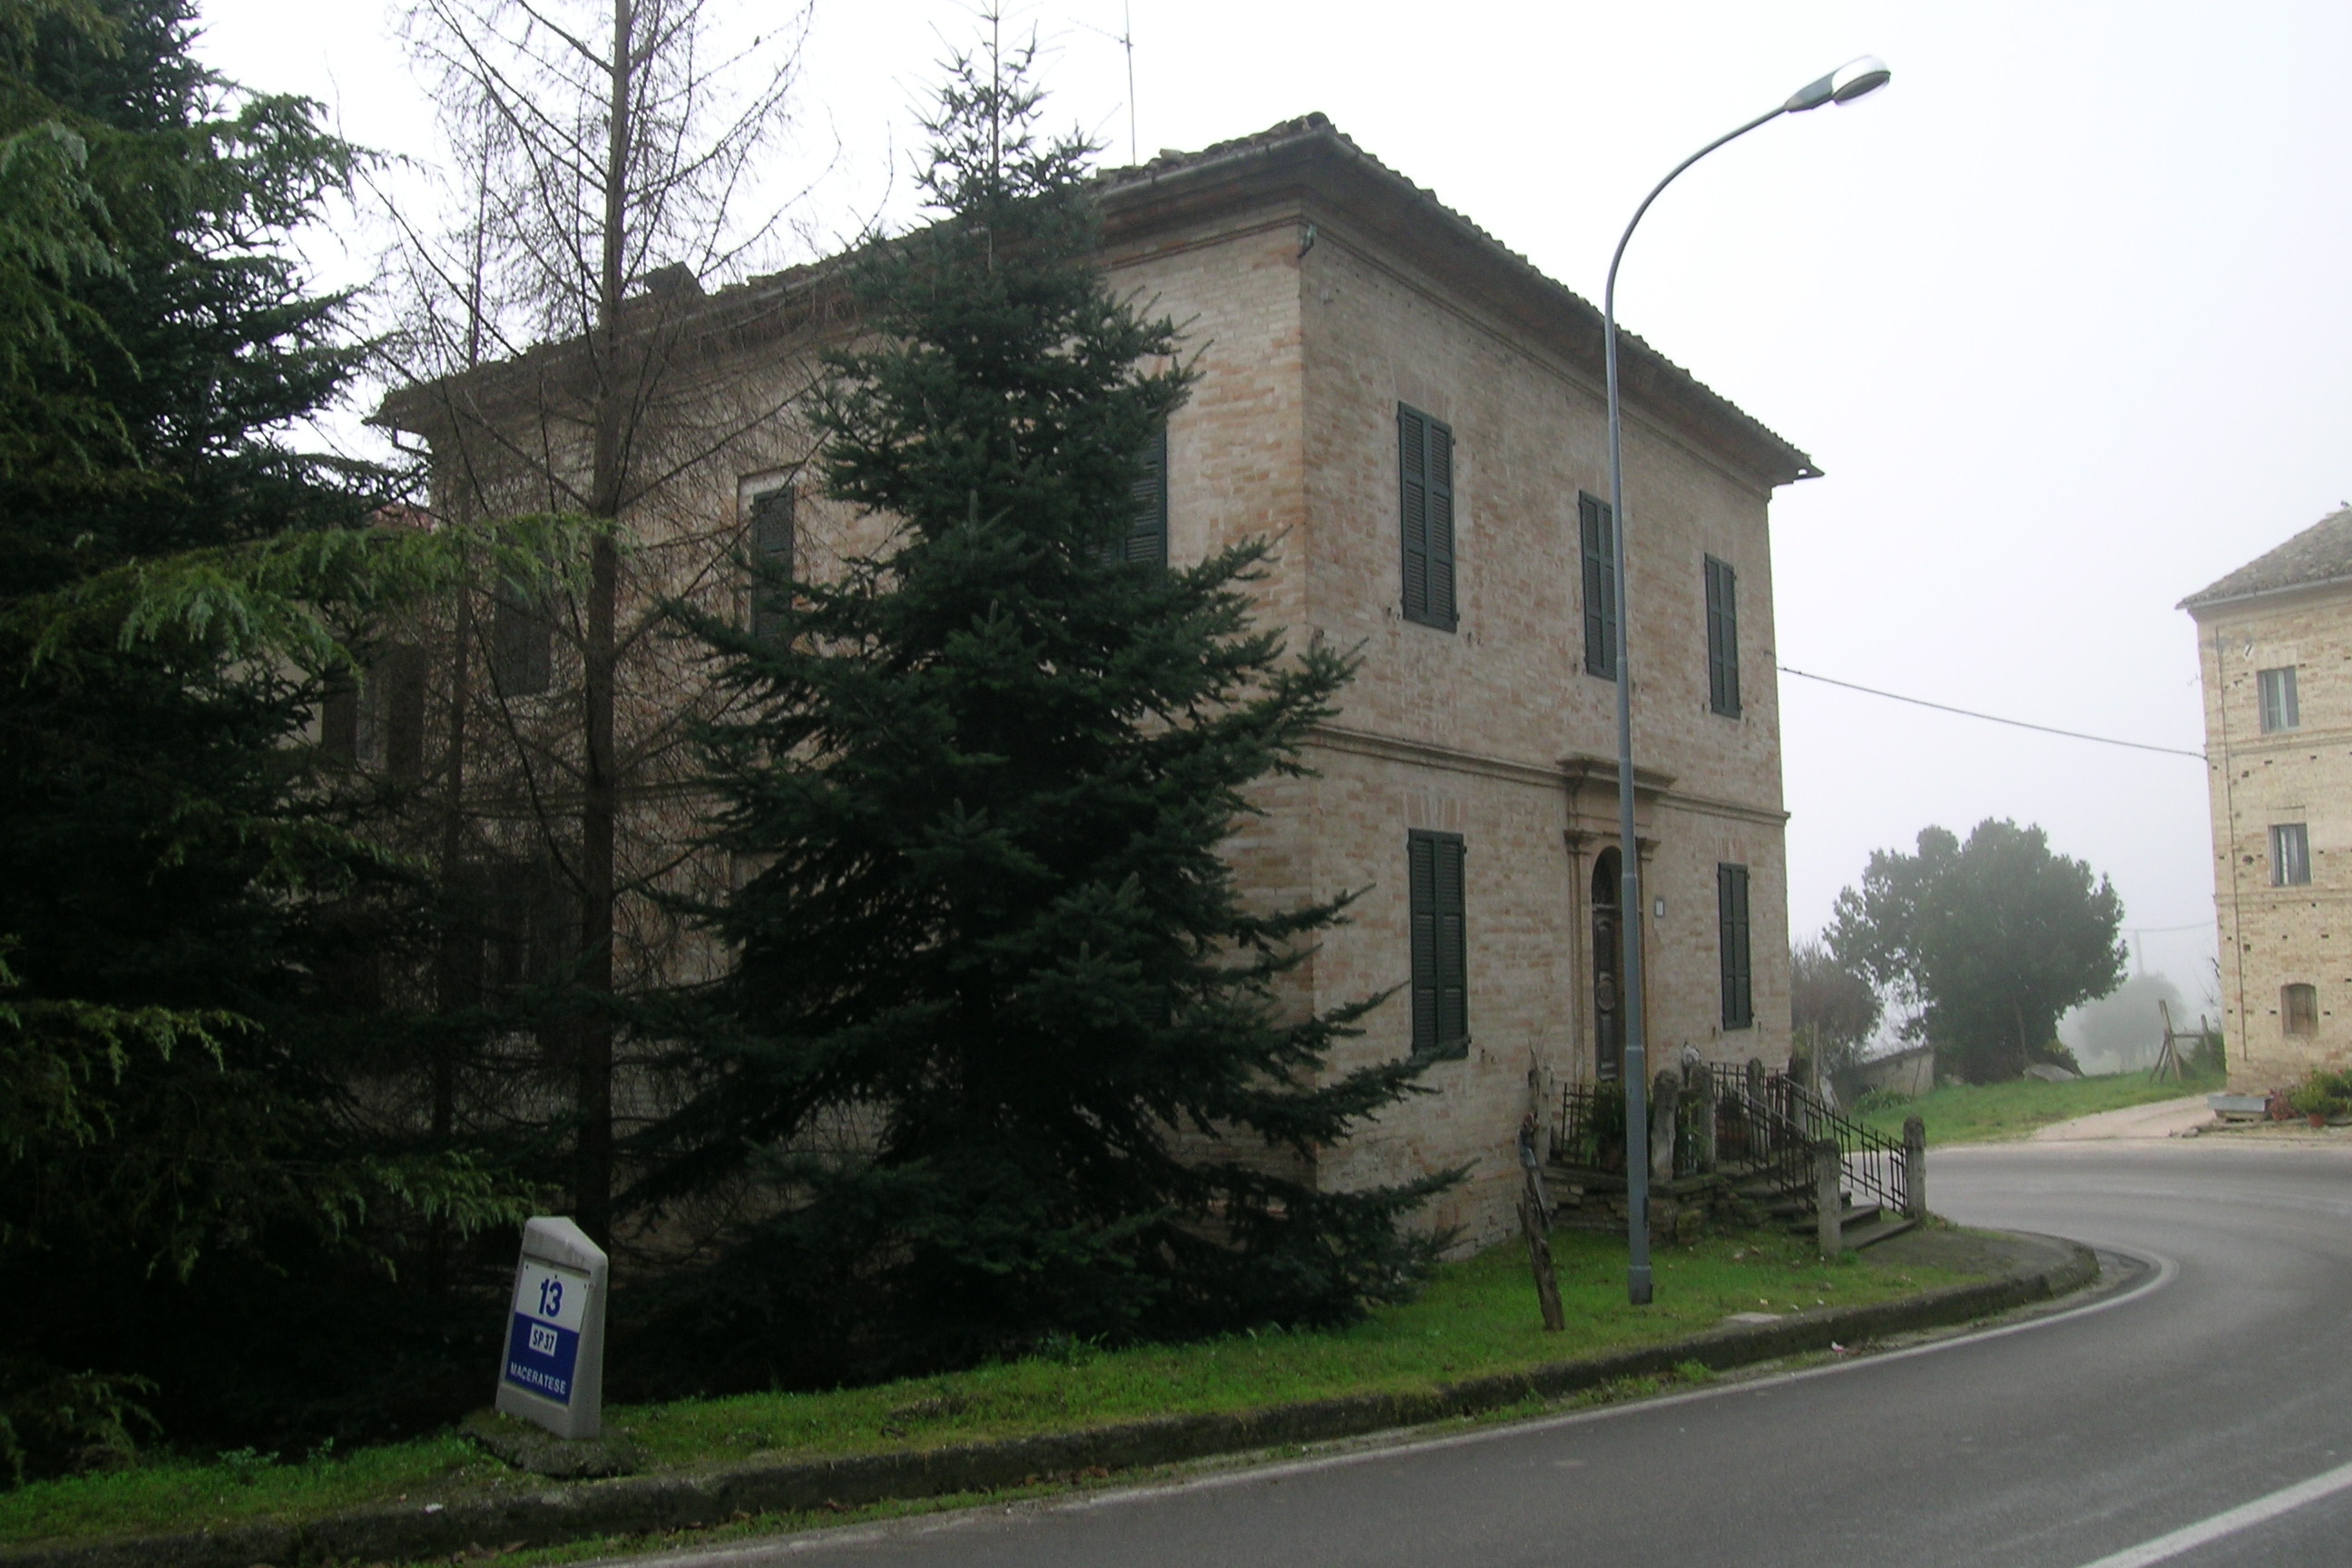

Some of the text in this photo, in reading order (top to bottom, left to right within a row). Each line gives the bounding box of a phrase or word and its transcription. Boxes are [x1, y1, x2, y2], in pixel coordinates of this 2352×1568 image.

[538, 1278, 563, 1318] 13
[533, 1328, 554, 1351] SP 37
[510, 1361, 567, 1395] MACERATESE
